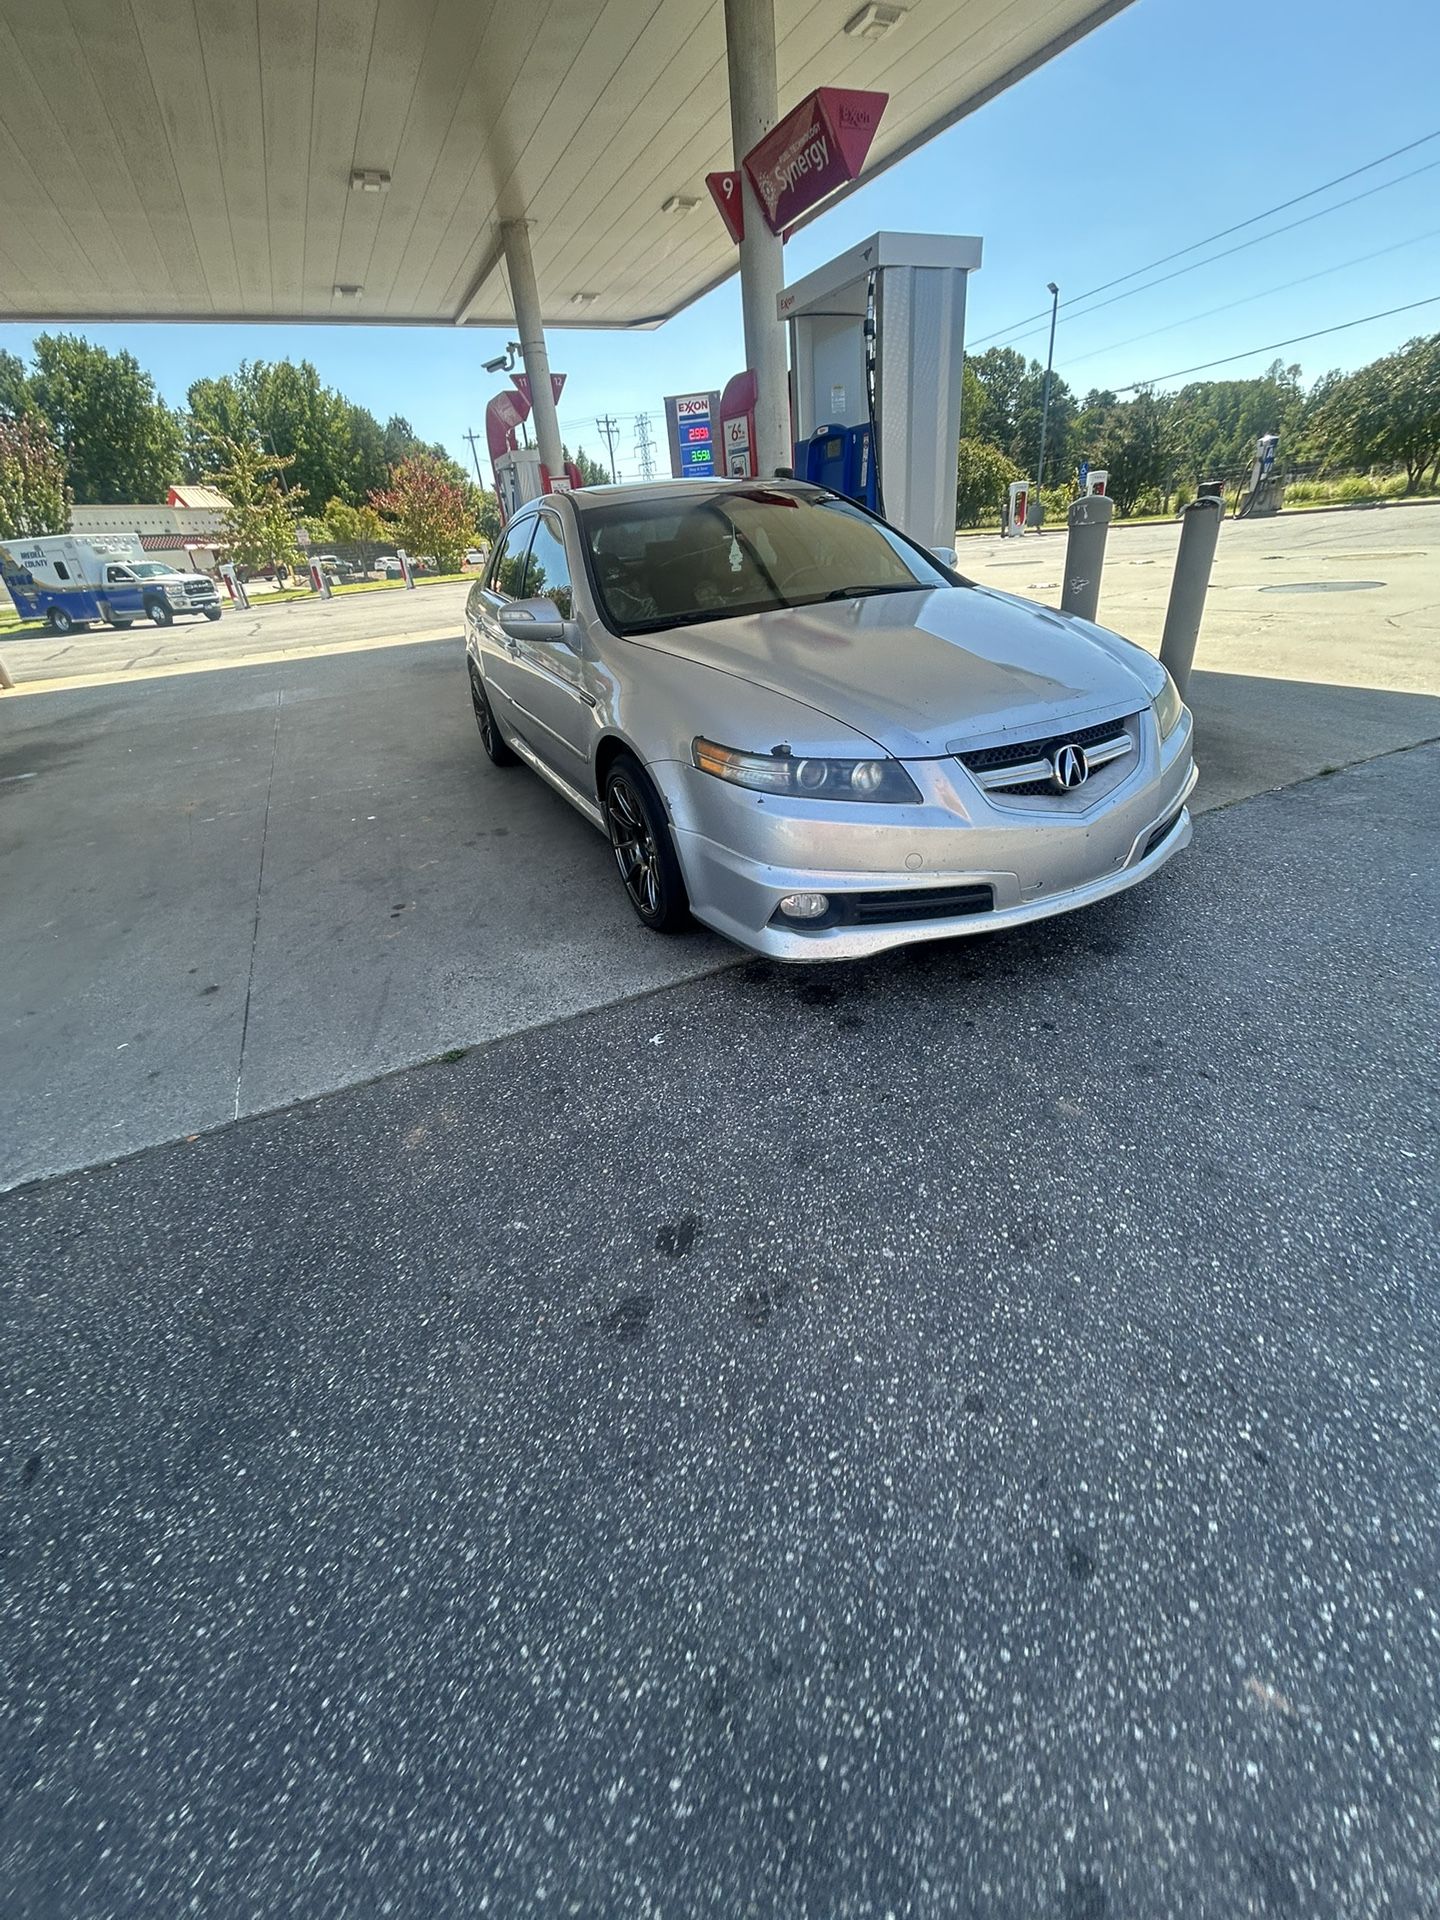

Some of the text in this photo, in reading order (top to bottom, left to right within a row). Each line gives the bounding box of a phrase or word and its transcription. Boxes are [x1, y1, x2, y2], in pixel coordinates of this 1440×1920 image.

[774, 135, 829, 193] Synergy
[722, 177, 734, 200] 9
[519, 378, 528, 387] 11
[554, 377, 562, 386] 12
[678, 400, 708, 414] EXXON
[24, 559, 48, 568] COUNTY
